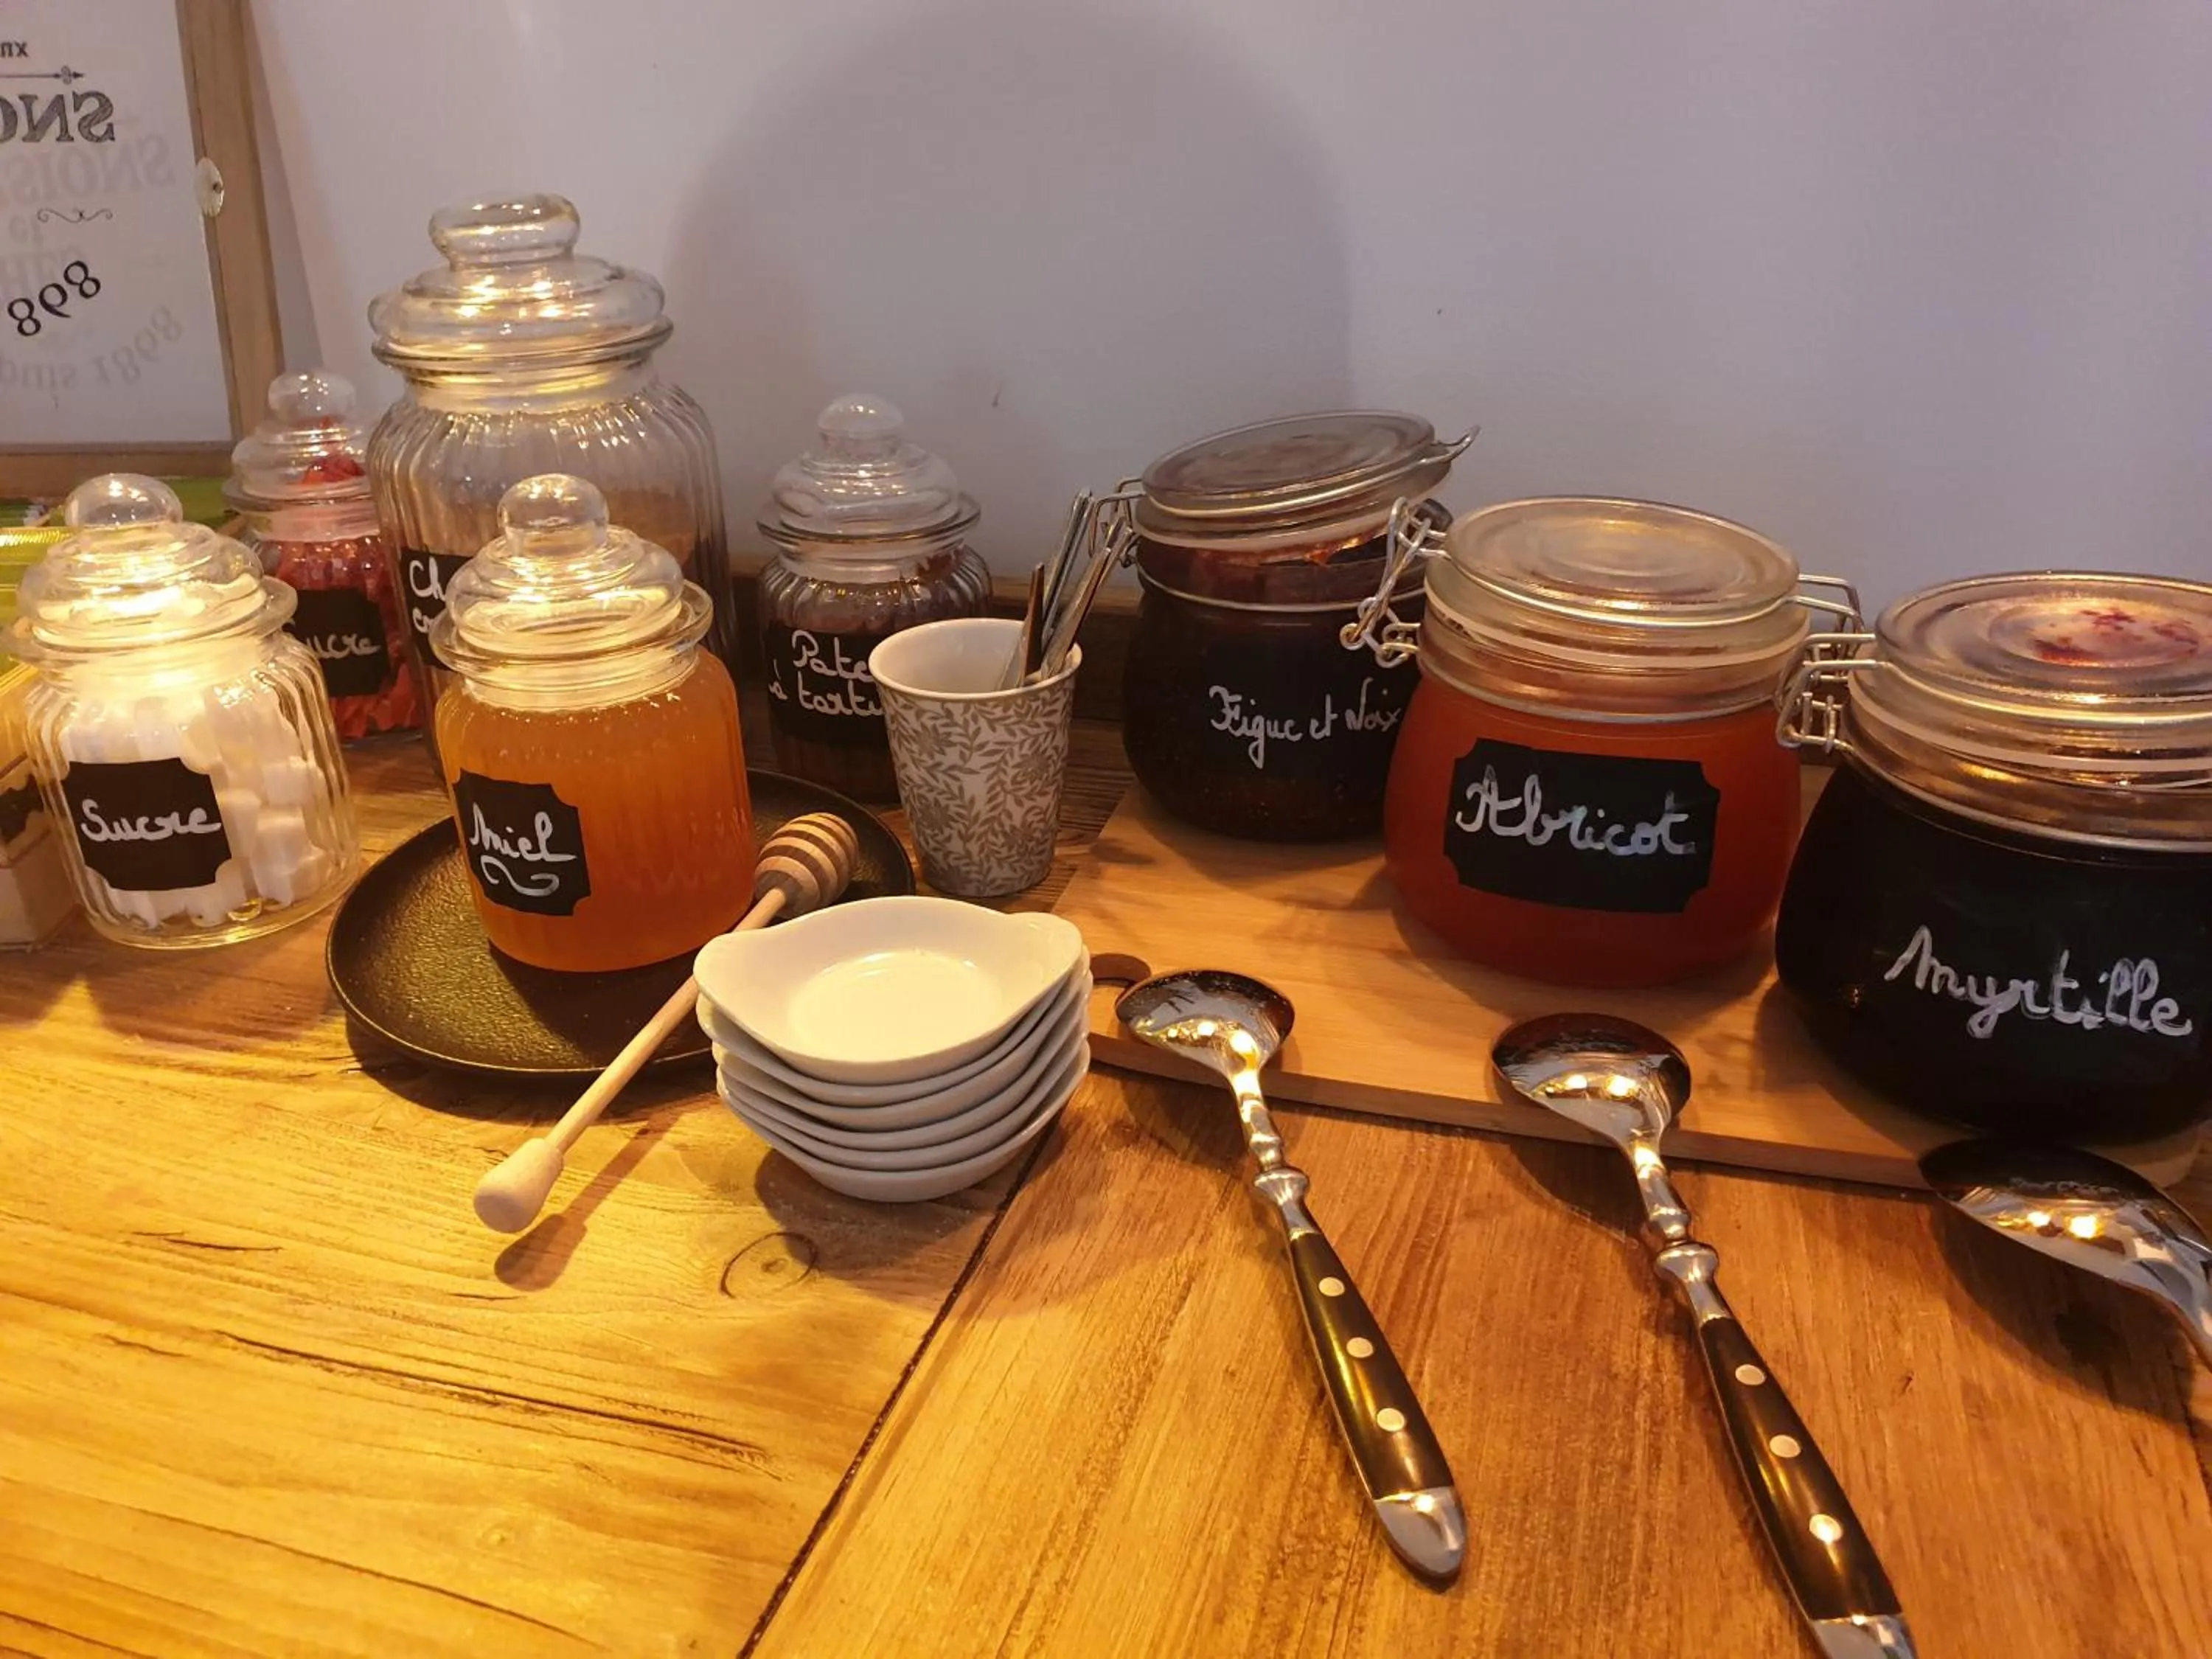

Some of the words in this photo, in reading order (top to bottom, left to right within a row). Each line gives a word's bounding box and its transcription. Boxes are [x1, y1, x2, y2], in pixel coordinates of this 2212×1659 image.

[305, 633, 382, 658] ucre
[1208, 685, 1303, 769] Figue
[1310, 694, 1338, 740] et
[80, 799, 221, 842] Sucre
[469, 801, 577, 862] Miel
[1455, 764, 1696, 855] Abricot
[1884, 925, 2192, 1039] Myrtille
